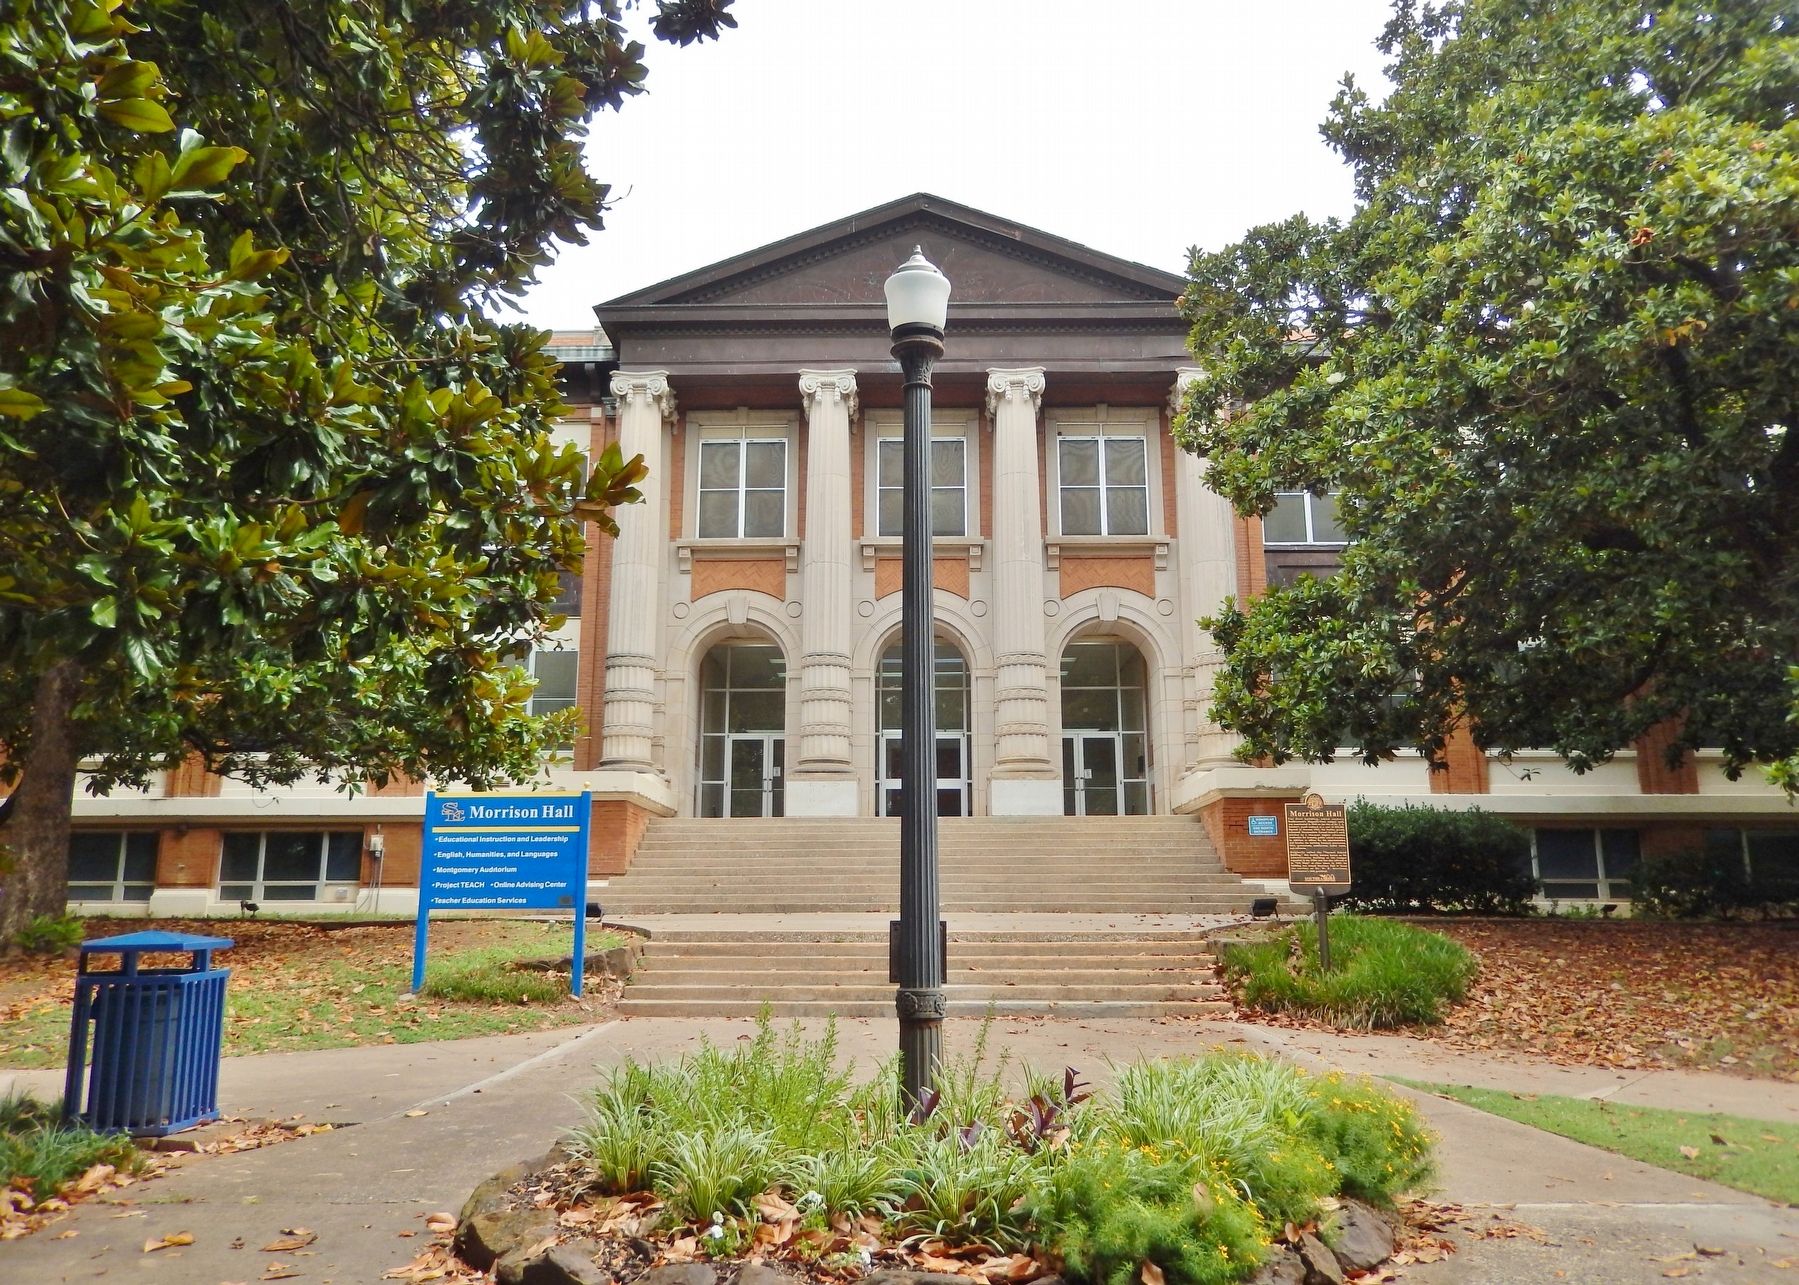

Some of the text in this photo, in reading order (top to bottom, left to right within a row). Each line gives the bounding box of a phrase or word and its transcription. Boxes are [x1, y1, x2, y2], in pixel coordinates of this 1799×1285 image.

[469, 805, 538, 819] Morrison
[542, 805, 574, 818] Hall
[530, 835, 569, 843] Leadership
[437, 851, 465, 859] English,
[465, 851, 506, 859] Humanities,
[520, 851, 559, 859] Languages
[436, 866, 479, 874] Montgomery
[435, 881, 460, 889] Project
[516, 881, 545, 889] Advising
[496, 896, 527, 904] Services
